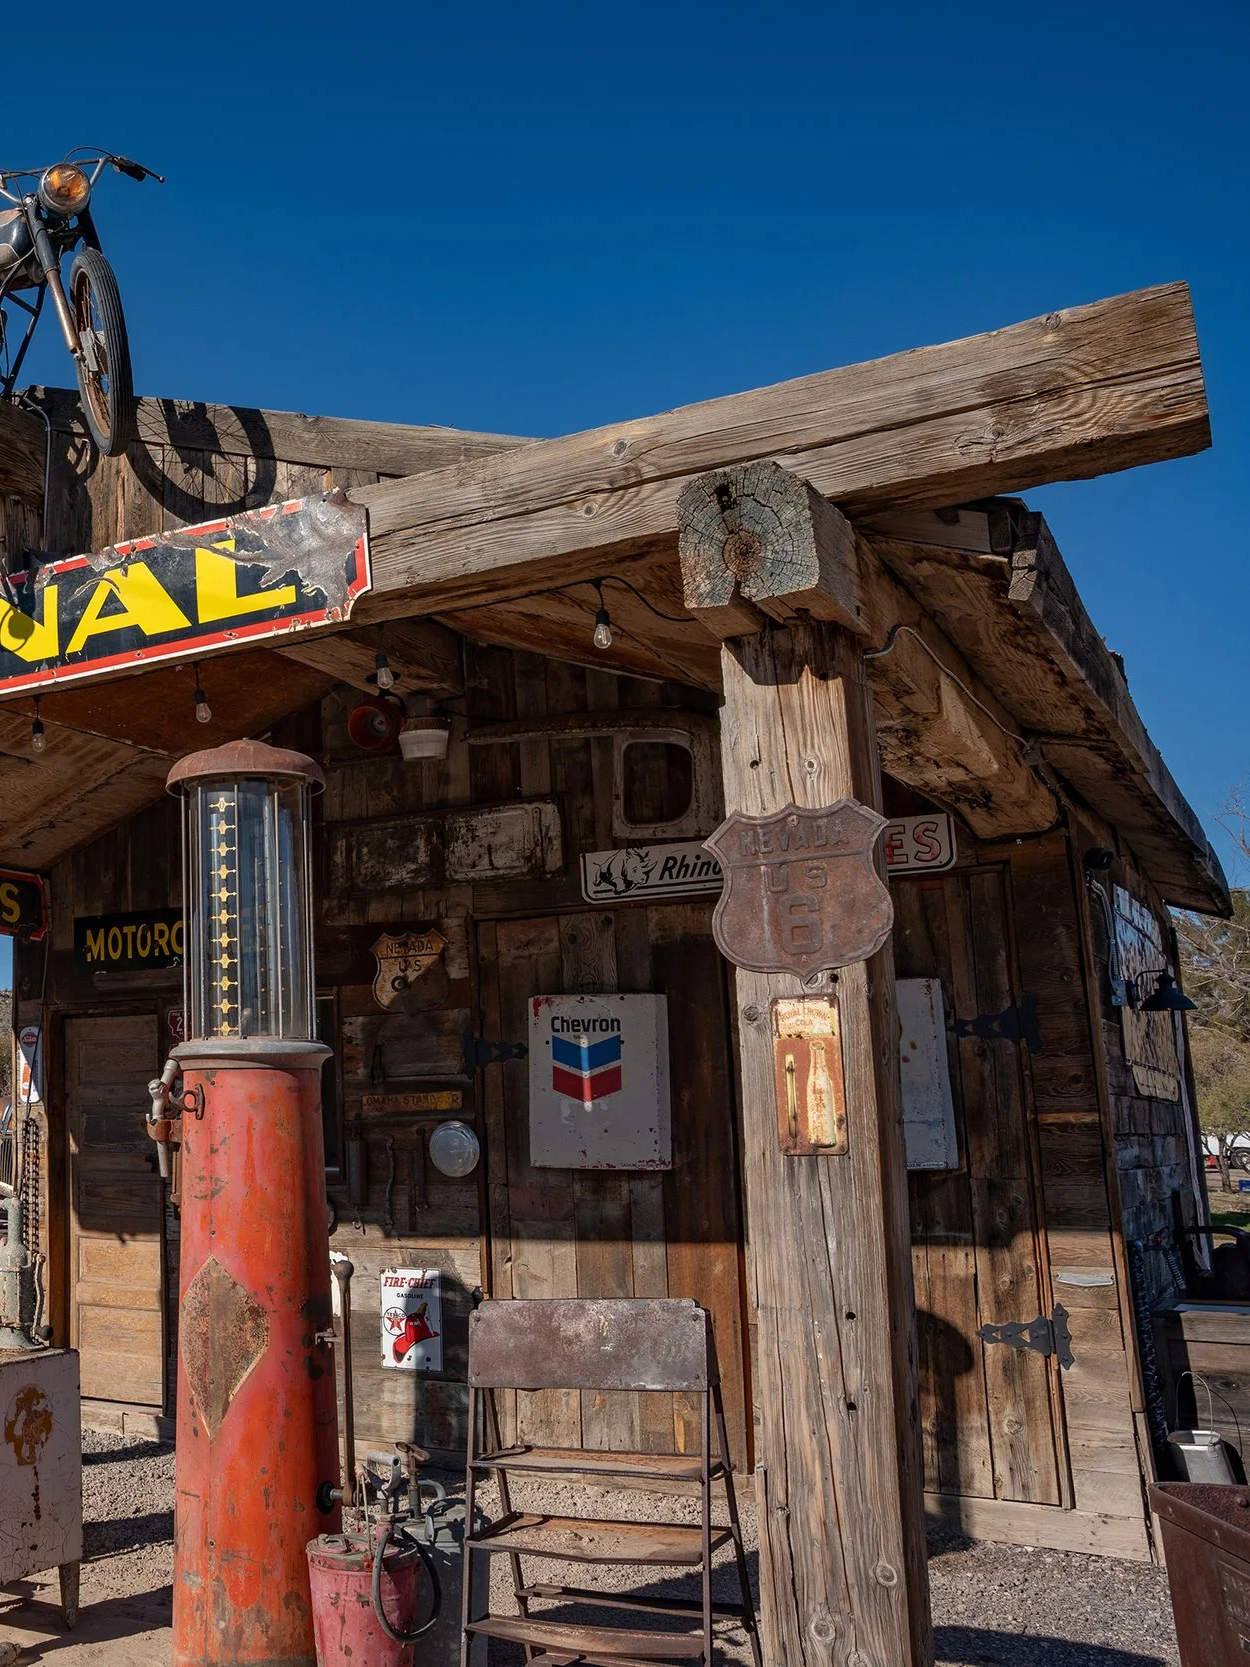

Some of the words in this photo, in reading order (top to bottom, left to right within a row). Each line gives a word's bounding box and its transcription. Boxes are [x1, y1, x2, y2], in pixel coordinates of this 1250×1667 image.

[740, 819, 849, 856] NEVADA
[777, 892, 824, 956] 6
[551, 1016, 621, 1033] Chevron
[383, 1276, 437, 1289] FIRE-CHIEF
[396, 1292, 425, 1300] GASOLINE
